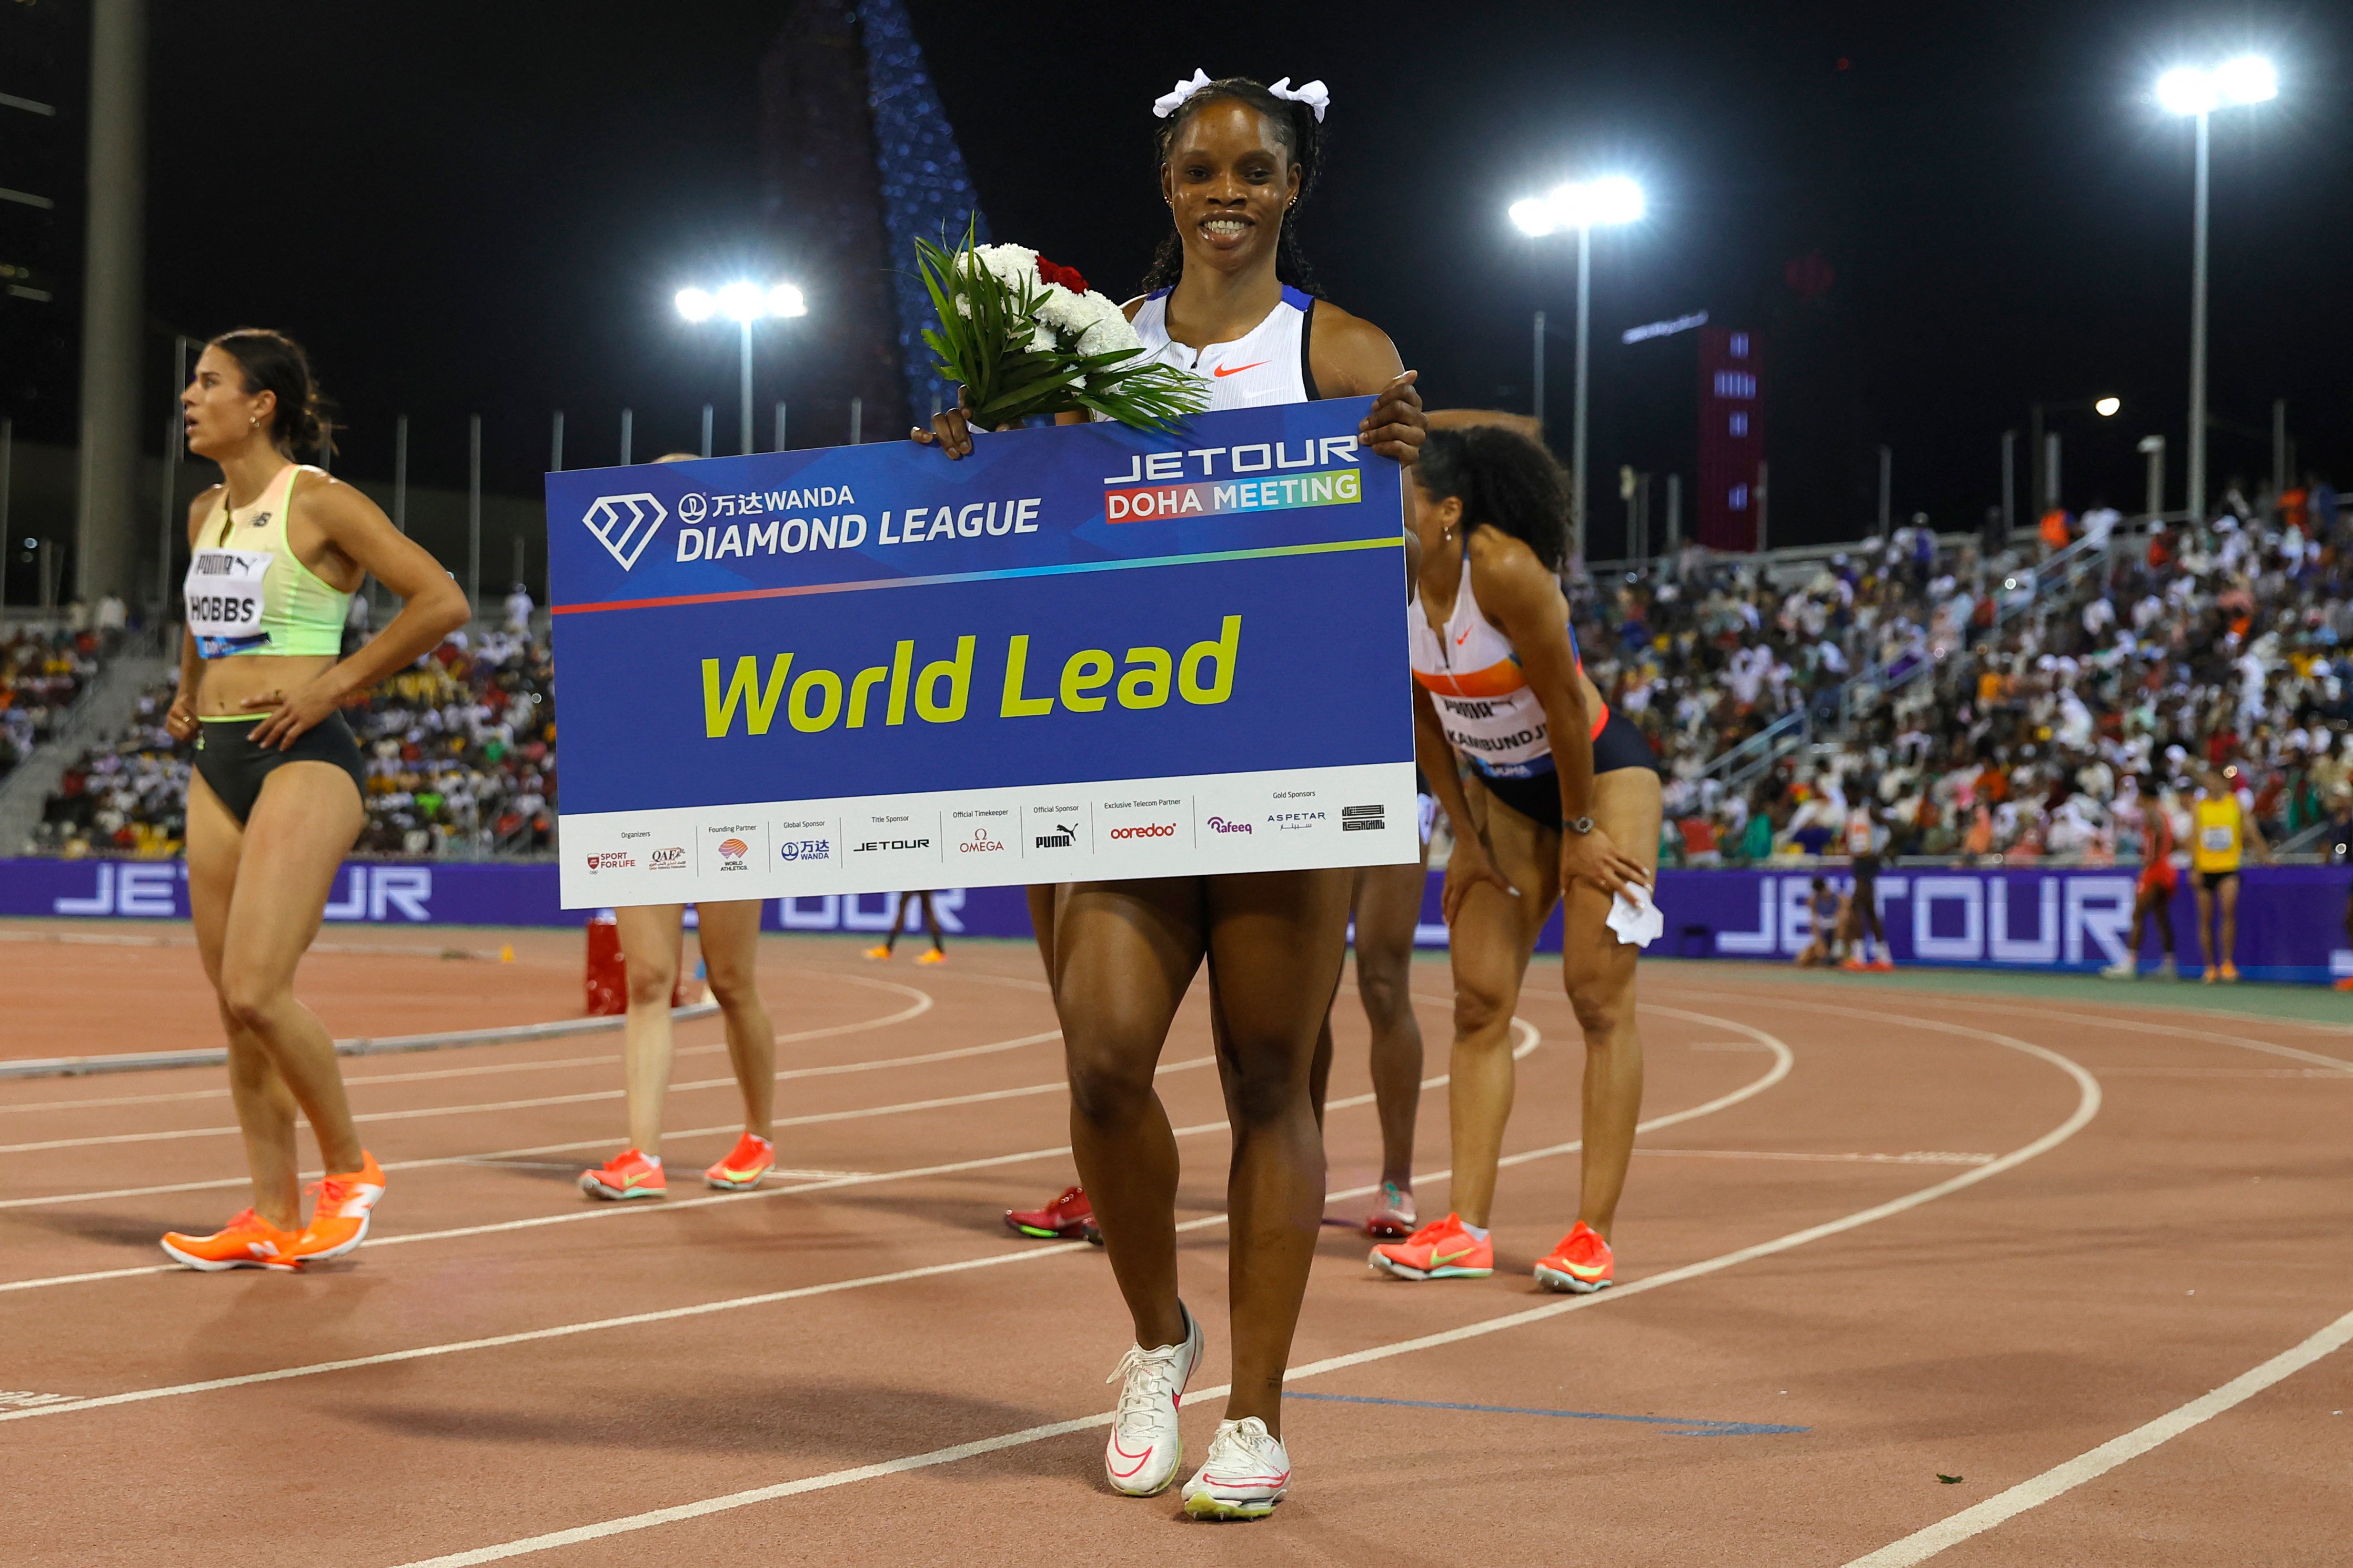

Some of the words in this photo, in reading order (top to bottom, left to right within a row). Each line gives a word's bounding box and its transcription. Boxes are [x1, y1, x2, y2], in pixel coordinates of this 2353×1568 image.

[1104, 434, 1360, 484] JETOUR
[712, 493, 763, 516] 万达
[764, 485, 855, 512] WANDA
[1109, 489, 1203, 519] DOHA
[1213, 474, 1358, 510] MEETING
[677, 514, 867, 562] DIAMOND
[878, 498, 1042, 546] LEAGUE
[190, 596, 256, 623] HOBBS
[701, 635, 976, 738] World
[1000, 614, 1242, 717] Lead
[974, 809, 1009, 817] Timekeeper
[1268, 812, 1326, 822] ASPETAR
[1110, 823, 1176, 839] ooredoo
[1208, 816, 1253, 834] Rafeeq
[621, 831, 651, 839] Organizers
[1036, 835, 1071, 848] PUMA
[800, 839, 830, 853] 万达
[853, 839, 930, 852] JETOUR
[959, 841, 1004, 853] OMEGA
[600, 852, 628, 860] SPORT
[652, 849, 677, 863] QAF
[53, 863, 432, 922] JEUR
